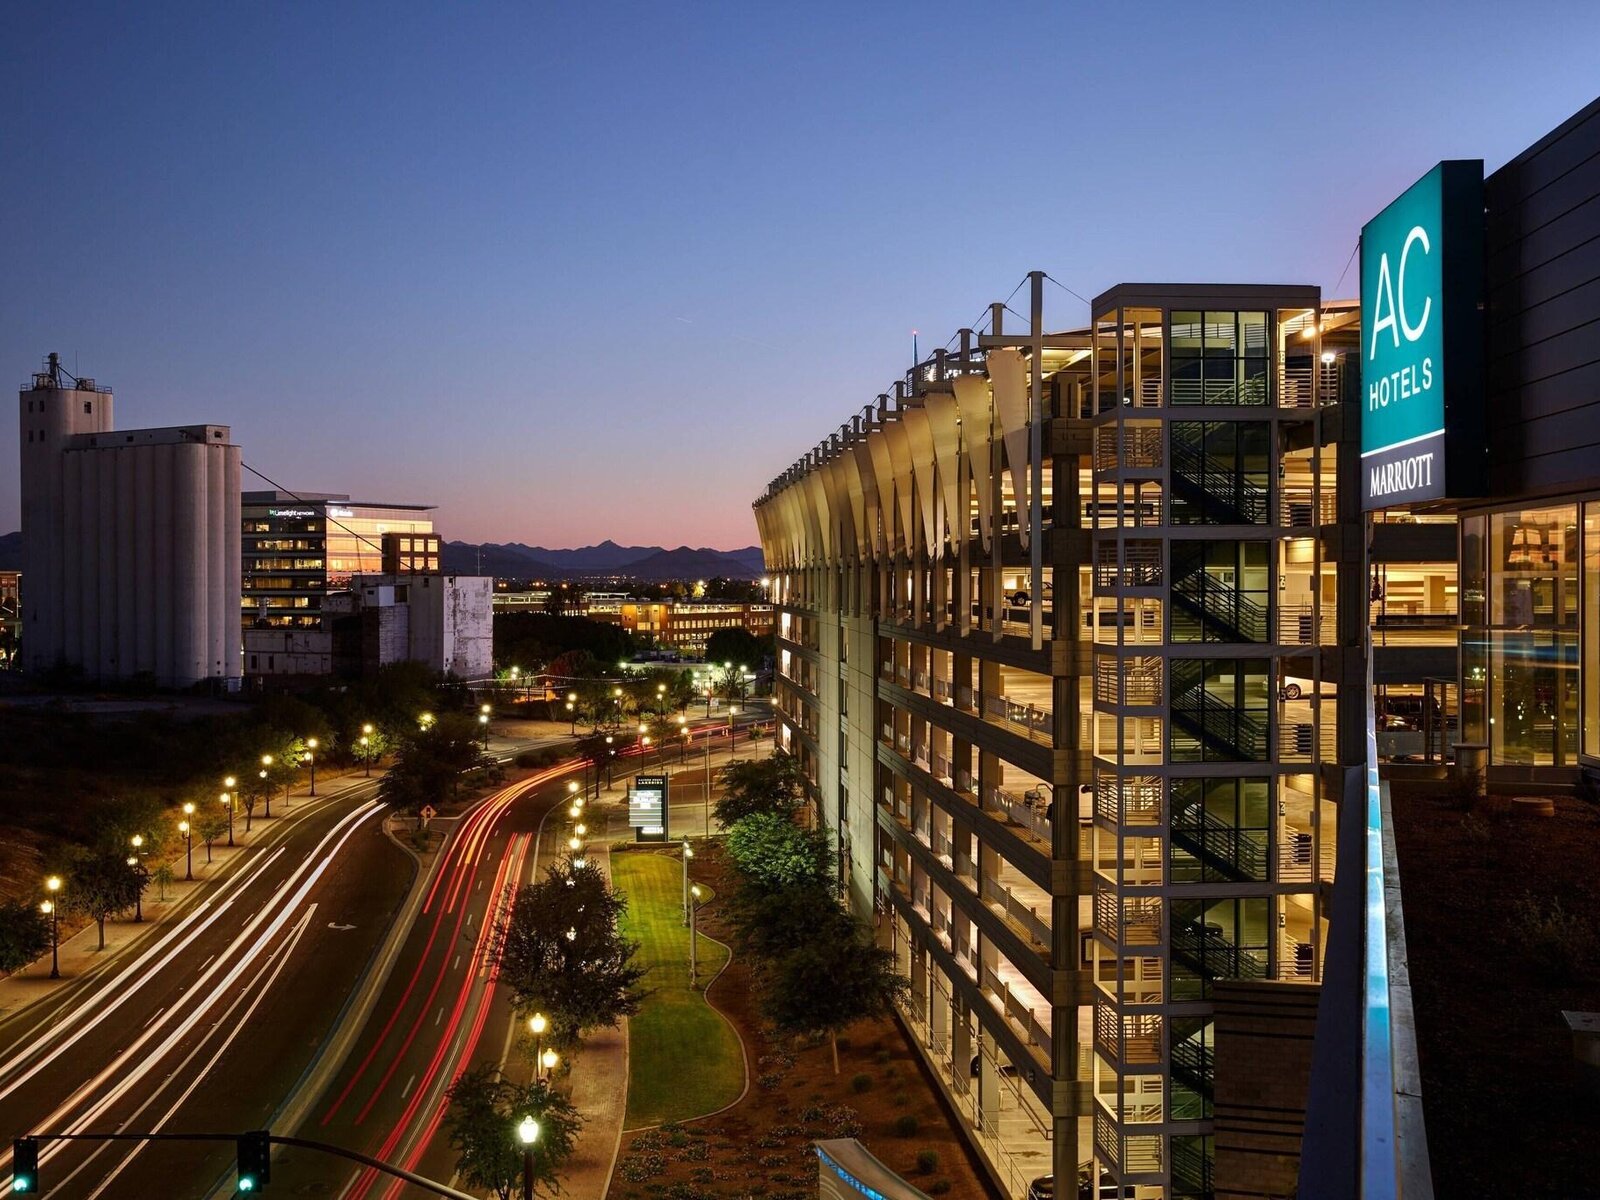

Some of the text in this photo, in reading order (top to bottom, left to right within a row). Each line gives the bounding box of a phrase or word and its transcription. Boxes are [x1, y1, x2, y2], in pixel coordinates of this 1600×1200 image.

[1370, 225, 1432, 361] AC
[1369, 356, 1433, 412] HOTELS
[1370, 453, 1433, 498] MARRIOTT
